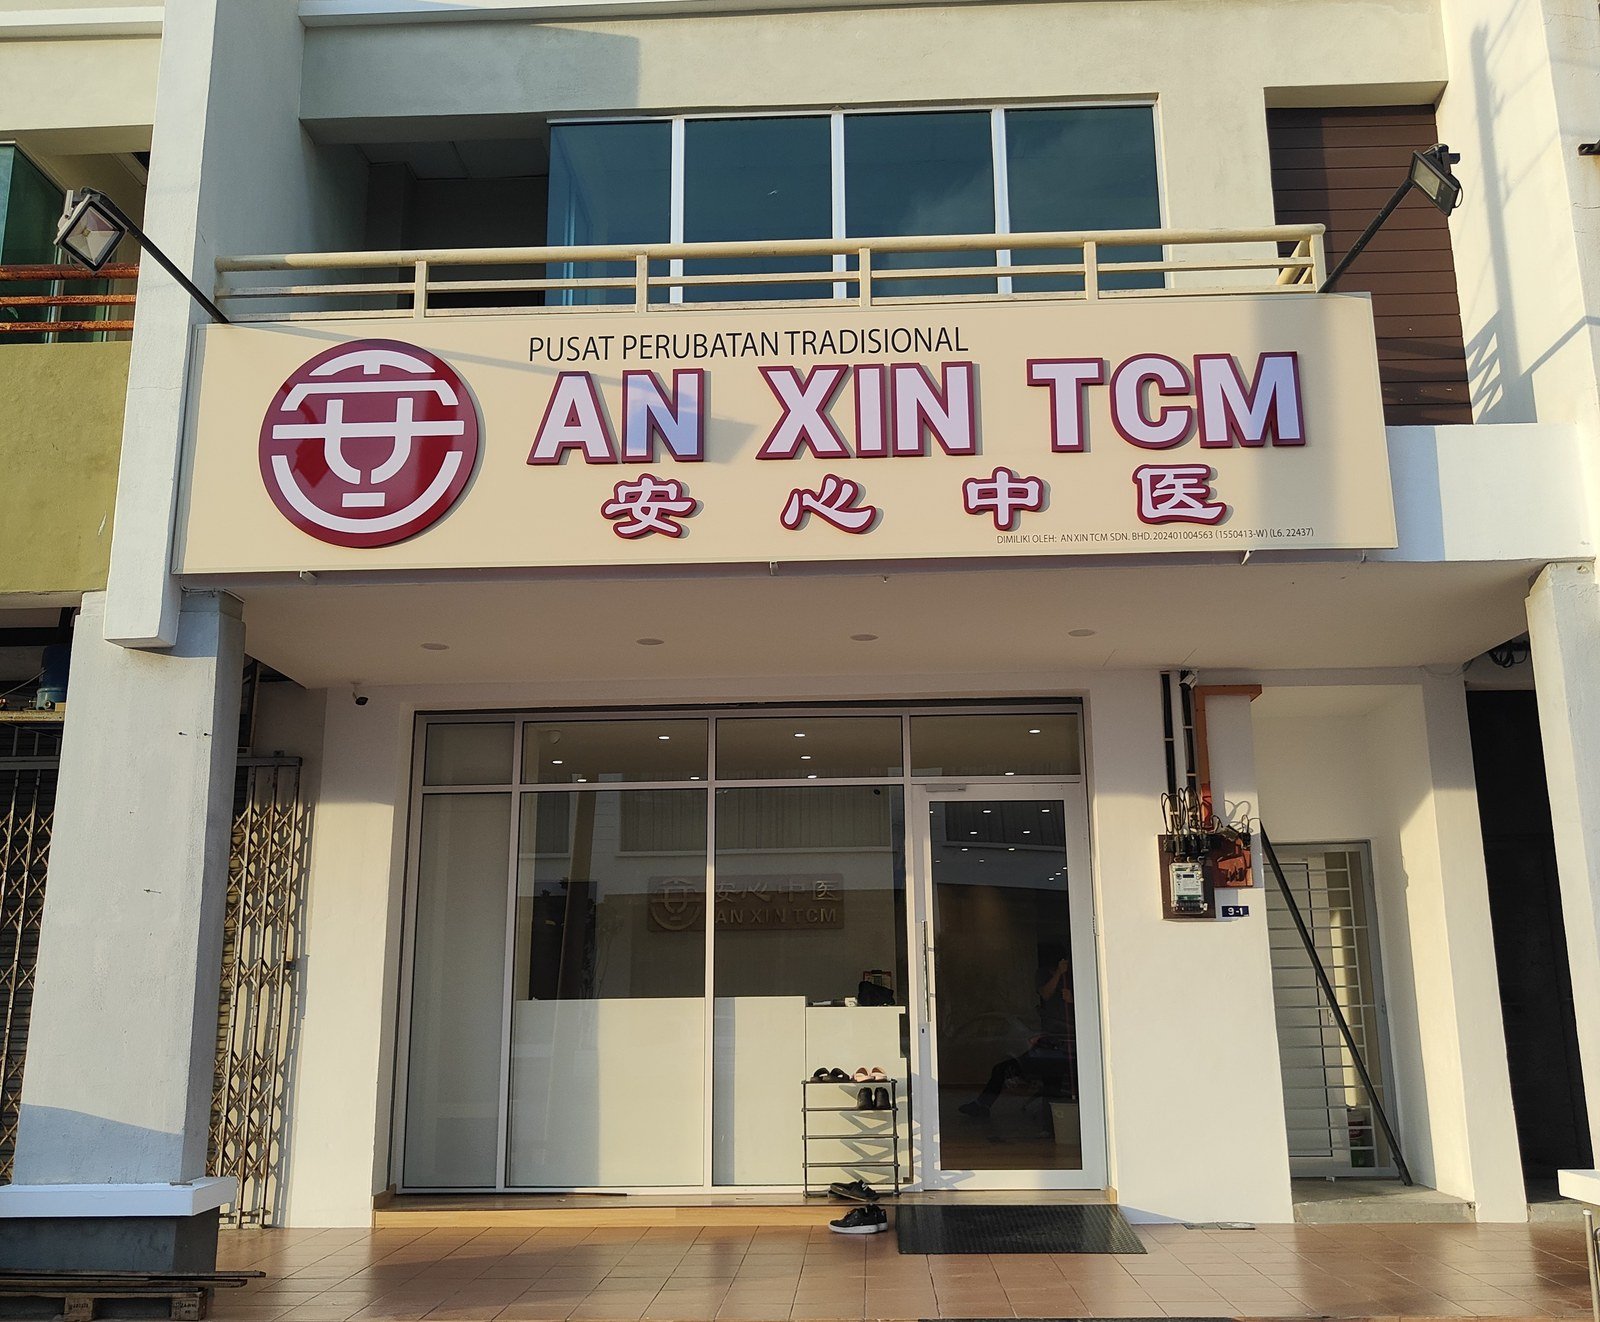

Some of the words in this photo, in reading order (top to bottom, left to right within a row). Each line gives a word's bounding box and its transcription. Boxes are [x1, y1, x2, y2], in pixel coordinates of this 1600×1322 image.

[529, 335, 615, 362] PUSAT
[622, 331, 779, 360] PERUBATAN
[785, 326, 969, 355] TRADISIONAL
[527, 368, 705, 465] AN
[755, 361, 976, 460] XIN
[1026, 351, 1306, 452] TCM
[601, 465, 1227, 538] 安心中医
[997, 535, 1030, 543] DIMILIKI
[1031, 534, 1057, 543] OLEH:
[1089, 533, 1108, 541] TCM
[1109, 532, 1131, 541] SDN.
[1214, 529, 1269, 539] (1550413-W)
[1285, 528, 1315, 538] 22437)
[715, 908, 745, 924] AN
[751, 908, 786, 924] XIN
[793, 907, 837, 923] TCM
[1228, 906, 1243, 916] 9-1
